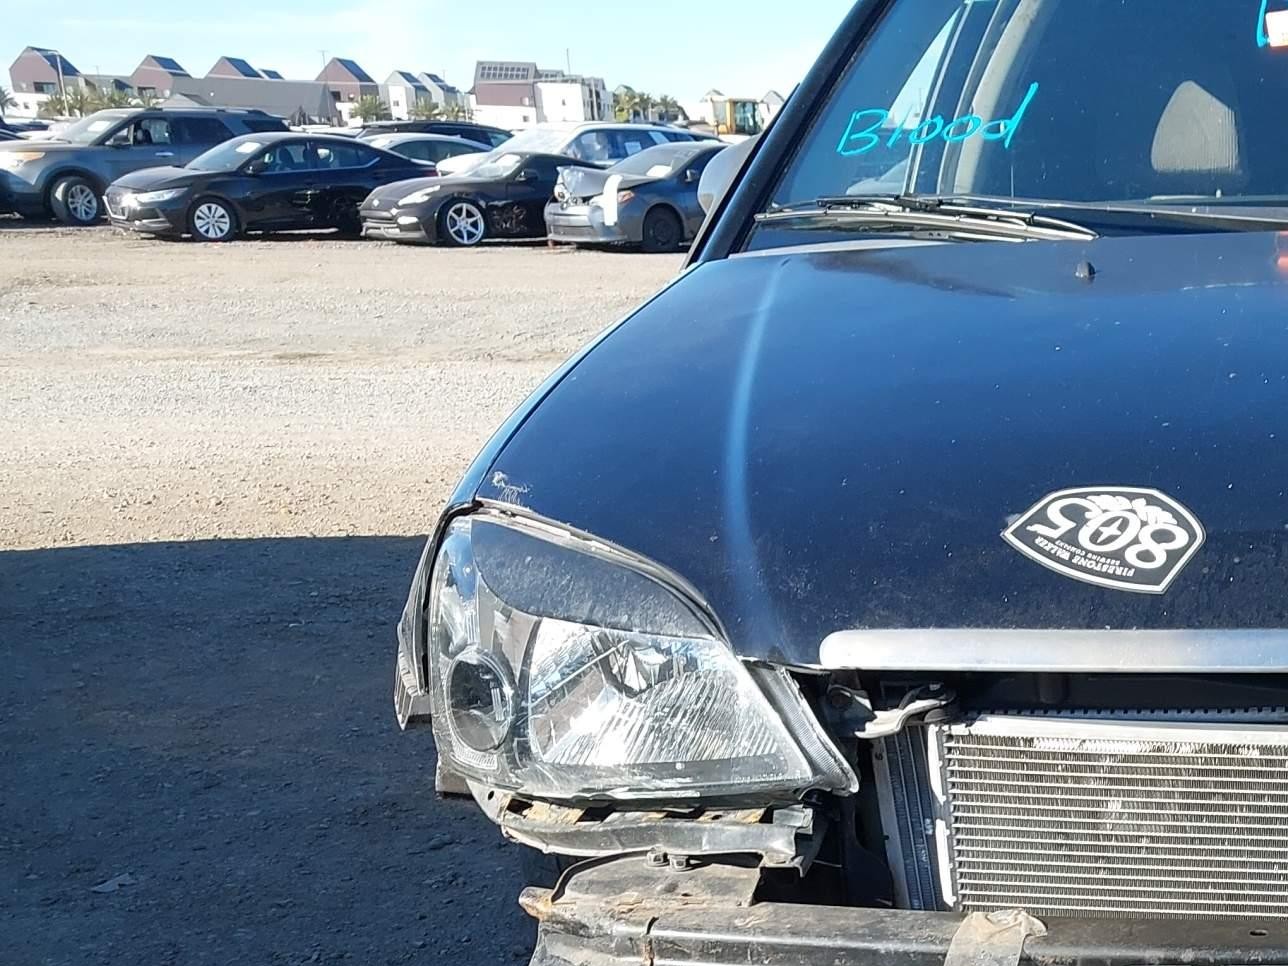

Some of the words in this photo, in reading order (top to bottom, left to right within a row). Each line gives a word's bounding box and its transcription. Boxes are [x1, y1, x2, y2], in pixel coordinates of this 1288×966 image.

[836, 81, 1038, 157] Blood
[1026, 498, 1189, 569] 805
[1033, 535, 1071, 562] WALKER
[1055, 539, 1086, 558] COMPANY
[1071, 553, 1135, 577] FIRESTONE
